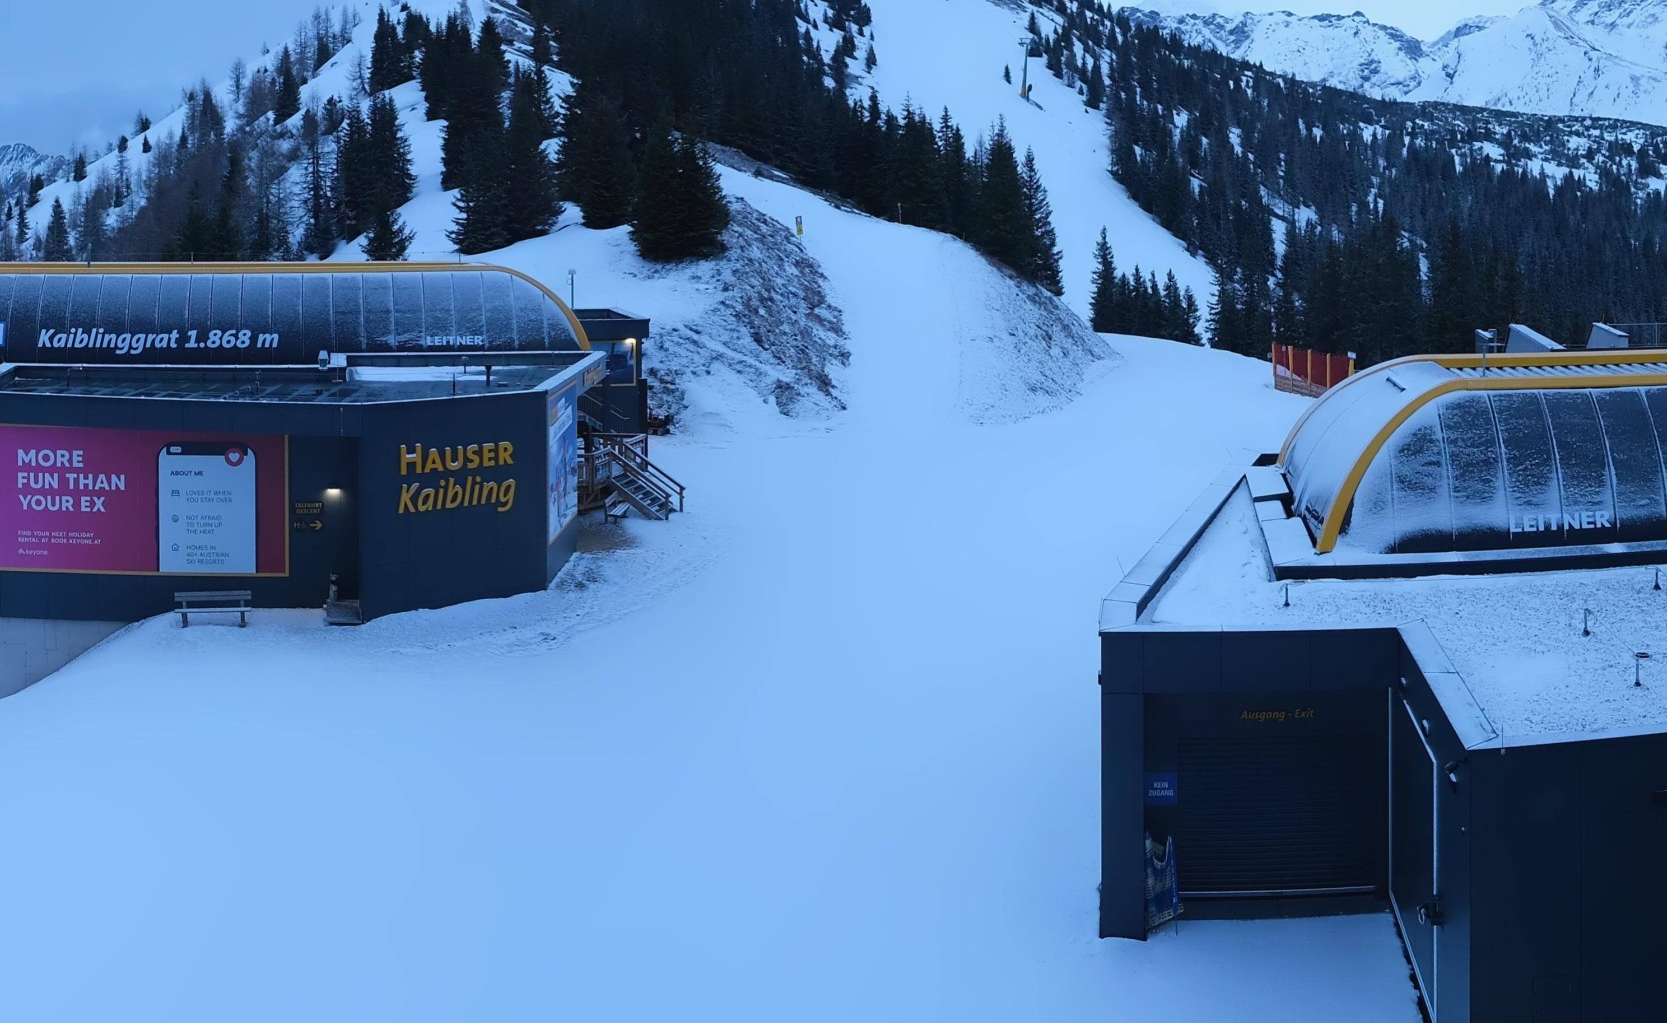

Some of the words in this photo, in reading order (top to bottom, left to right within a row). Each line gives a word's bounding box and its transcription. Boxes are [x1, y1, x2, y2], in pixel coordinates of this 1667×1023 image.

[37, 328, 179, 354] Kaiblinggrat
[184, 328, 252, 349] 1.868
[256, 332, 280, 348] m
[426, 335, 484, 346] LEITNER
[17, 448, 84, 468] MORE
[400, 441, 515, 476] HAUSER
[17, 472, 59, 489] FUN
[66, 473, 126, 491] THAN
[18, 494, 74, 512] YOUR
[80, 496, 106, 512] EX
[398, 475, 517, 514] Kaibling
[1509, 510, 1612, 533] LEITNER
[1241, 710, 1286, 721] Ausgang
[1294, 708, 1314, 719] Exit
[1148, 789, 1174, 797] ZUGANG
[1153, 781, 1169, 789] KEIN
